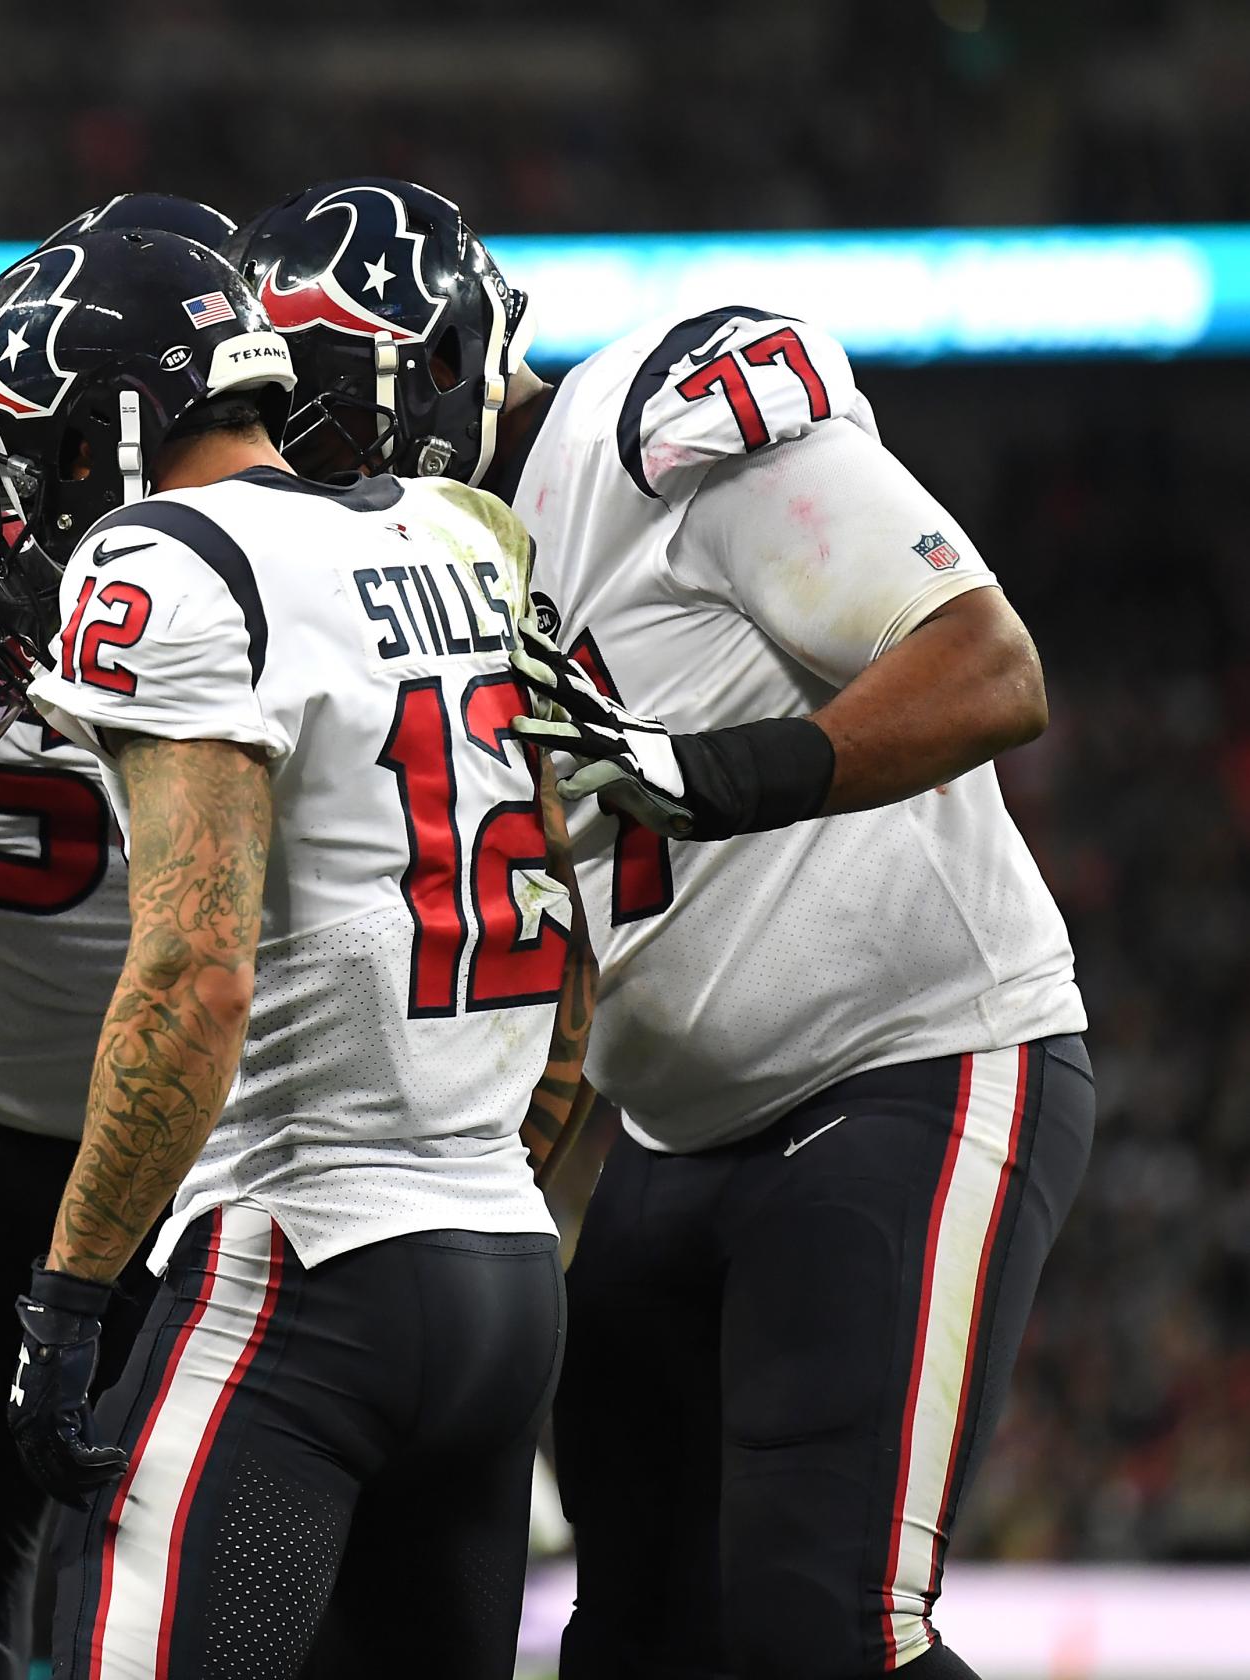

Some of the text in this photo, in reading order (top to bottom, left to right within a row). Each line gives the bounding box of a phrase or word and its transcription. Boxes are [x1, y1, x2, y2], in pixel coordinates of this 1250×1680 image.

[229, 347, 287, 363] TEXANS
[675, 327, 831, 454] 77
[60, 575, 153, 697] 12
[353, 561, 515, 660] STILLS
[375, 670, 571, 1019] 12
